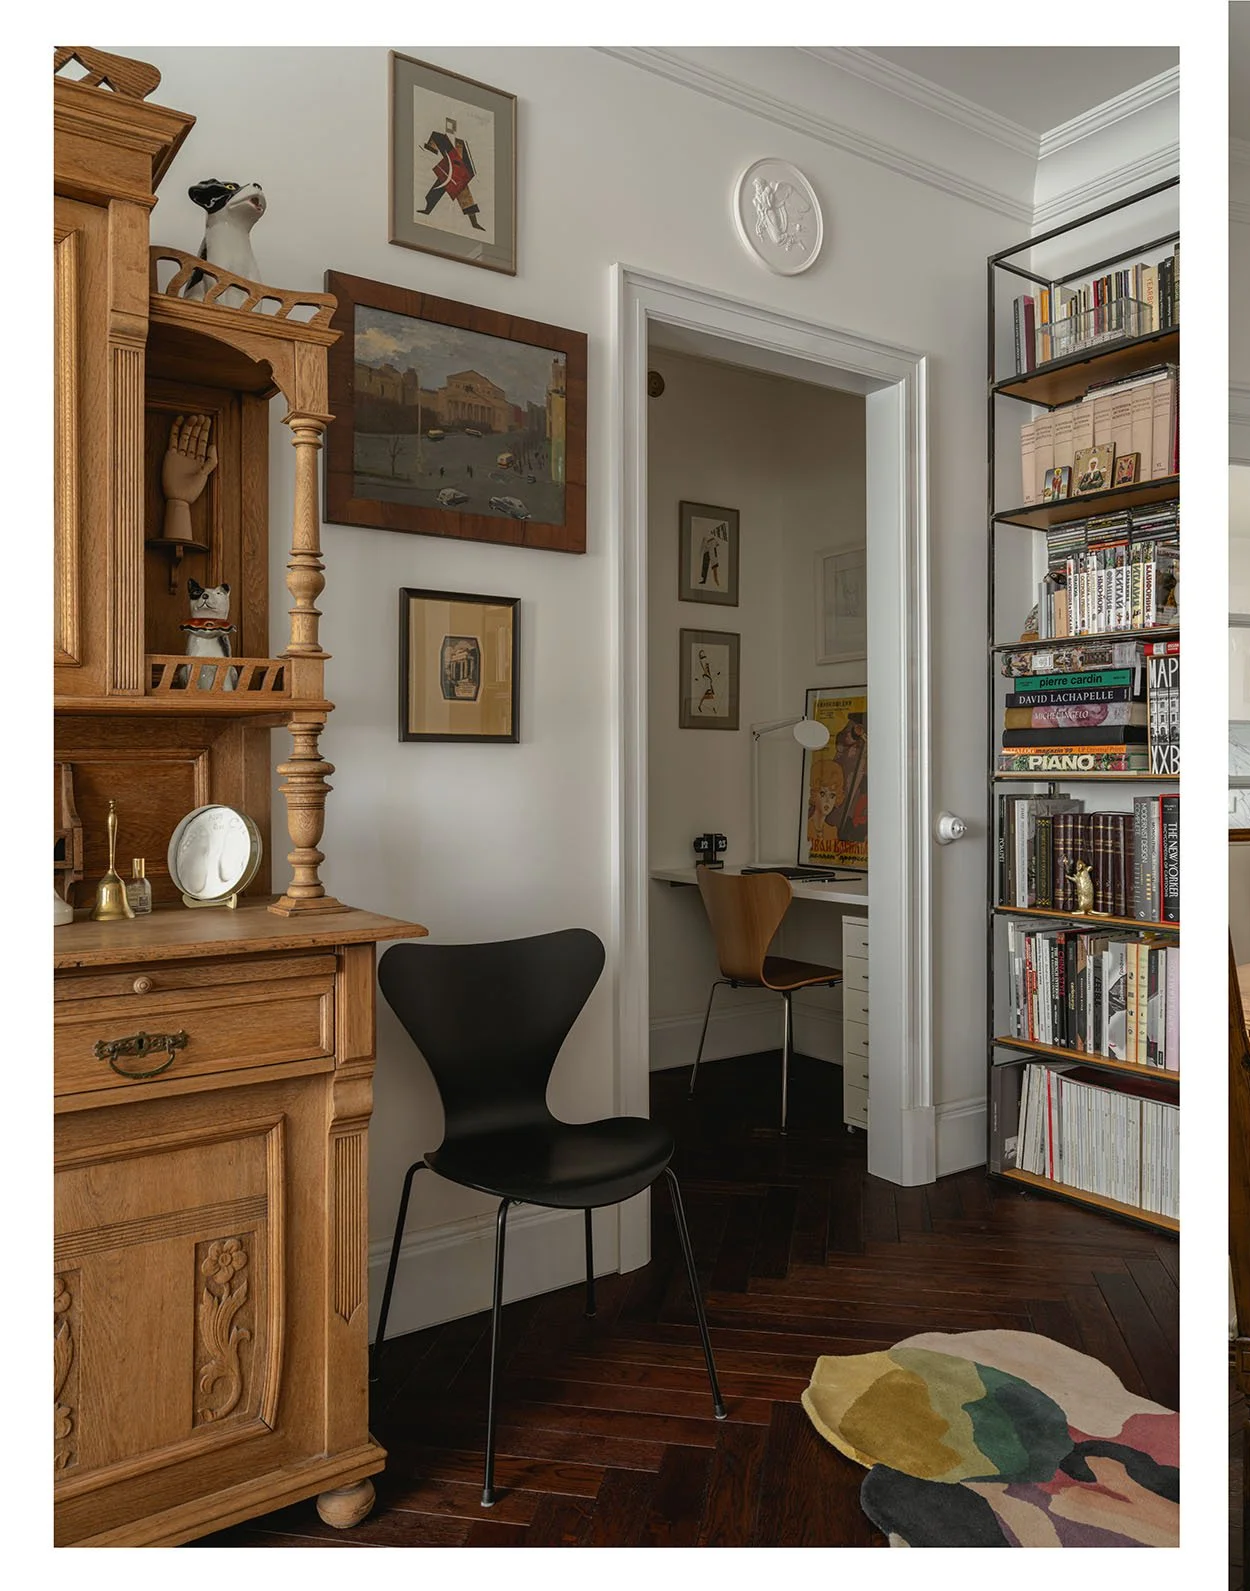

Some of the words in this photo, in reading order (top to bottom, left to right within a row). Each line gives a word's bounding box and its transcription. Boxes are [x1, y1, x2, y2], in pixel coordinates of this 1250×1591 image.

[1097, 575, 1105, 615] НЬЮ-ЙОРК
[1115, 568, 1126, 610] КИТАЙ
[1132, 564, 1141, 606] ИТАЛИЯ
[1145, 564, 1153, 613] КАЛИФОРНИЯ
[1039, 677, 1068, 688] pierre
[1070, 674, 1103, 685] cardin
[1019, 694, 1048, 704] DAVID
[1050, 690, 1114, 703] LACHAPELLE
[1034, 710, 1089, 720] MICHELANGELO
[1028, 754, 1095, 770] PIANO
[1168, 822, 1178, 839] THE
[1168, 840, 1178, 862] NEW
[1168, 862, 1179, 898] YORKER
